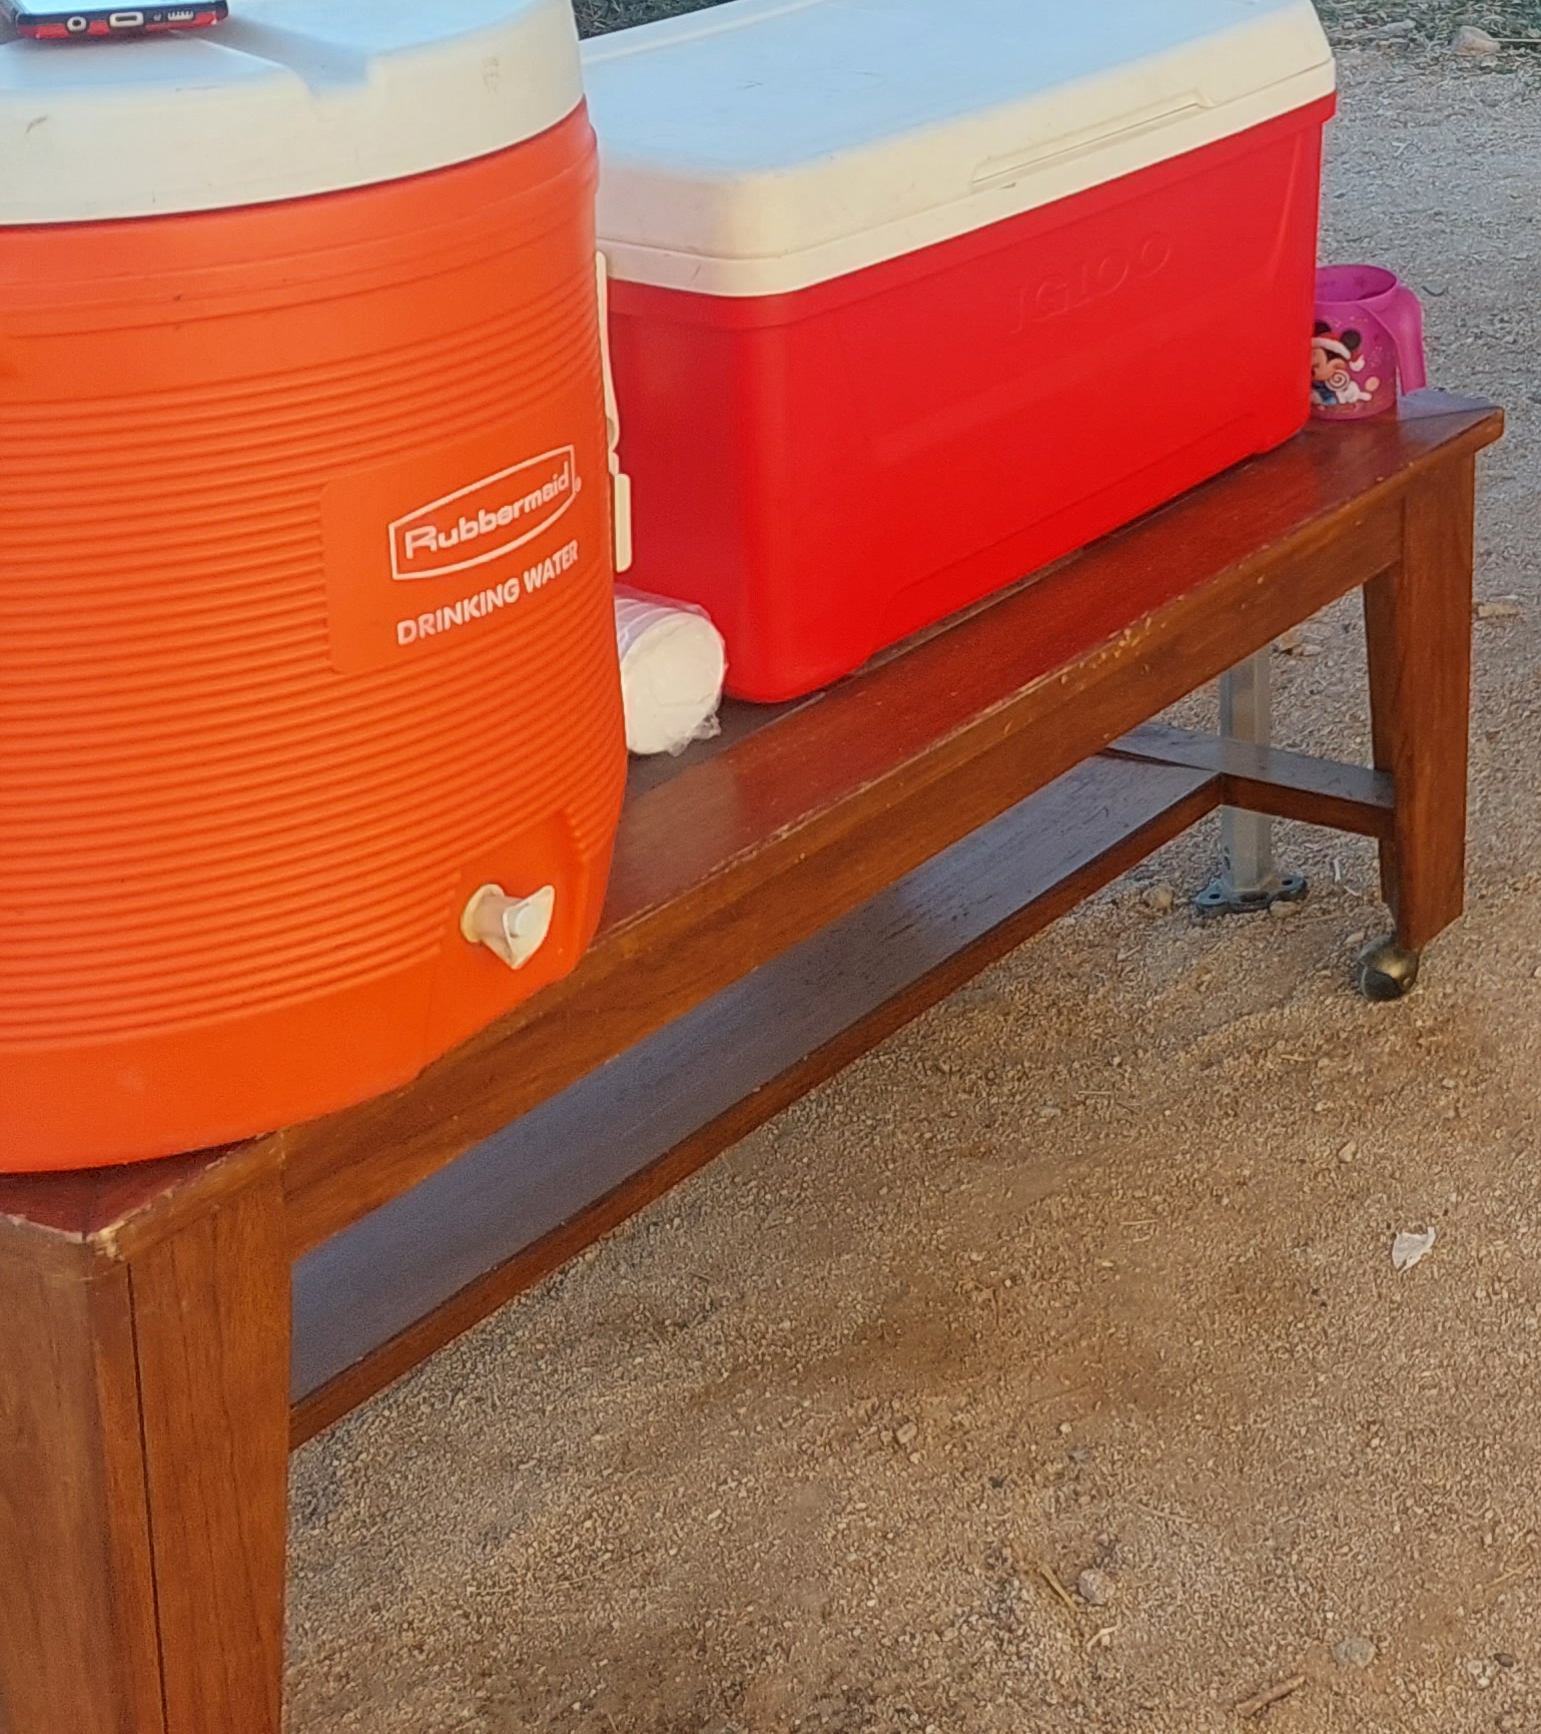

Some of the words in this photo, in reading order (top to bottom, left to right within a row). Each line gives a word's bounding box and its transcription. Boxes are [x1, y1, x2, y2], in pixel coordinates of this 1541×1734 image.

[404, 460, 570, 560] Rubbermaid
[396, 576, 521, 646] DRINKING
[522, 538, 580, 594] WATER
